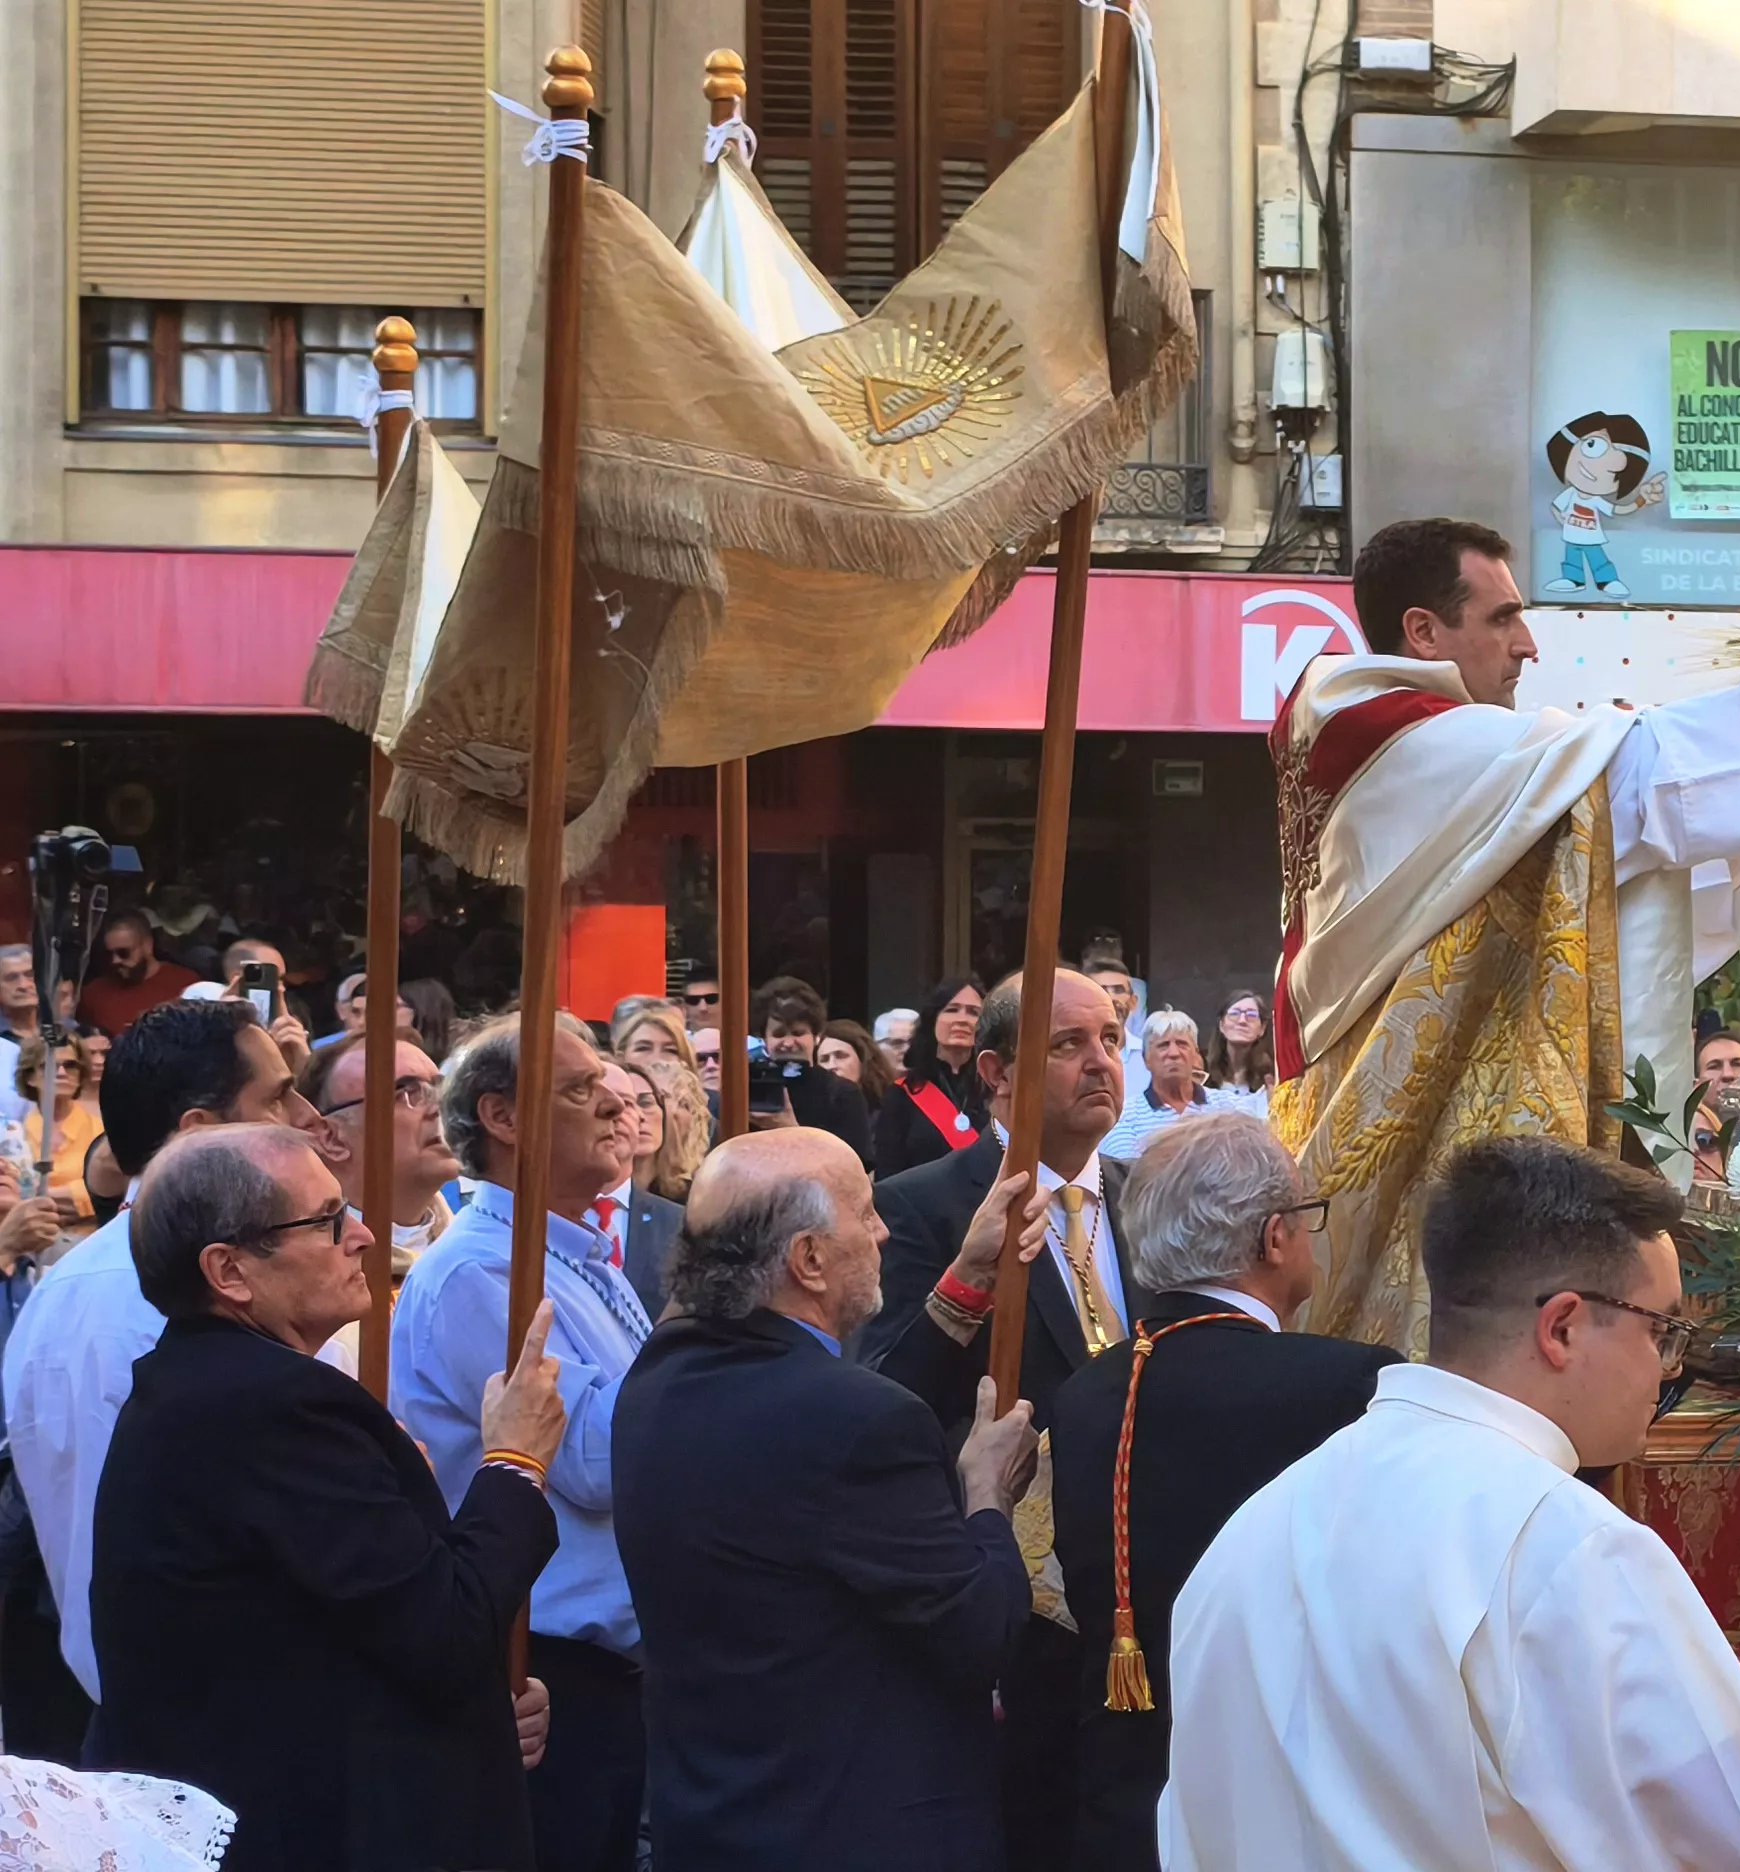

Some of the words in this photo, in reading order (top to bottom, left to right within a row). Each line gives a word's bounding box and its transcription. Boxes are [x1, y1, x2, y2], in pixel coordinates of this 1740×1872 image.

[1677, 394, 1698, 417] AL
[1661, 574, 1692, 591] DE
[1699, 574, 1727, 593] LA
